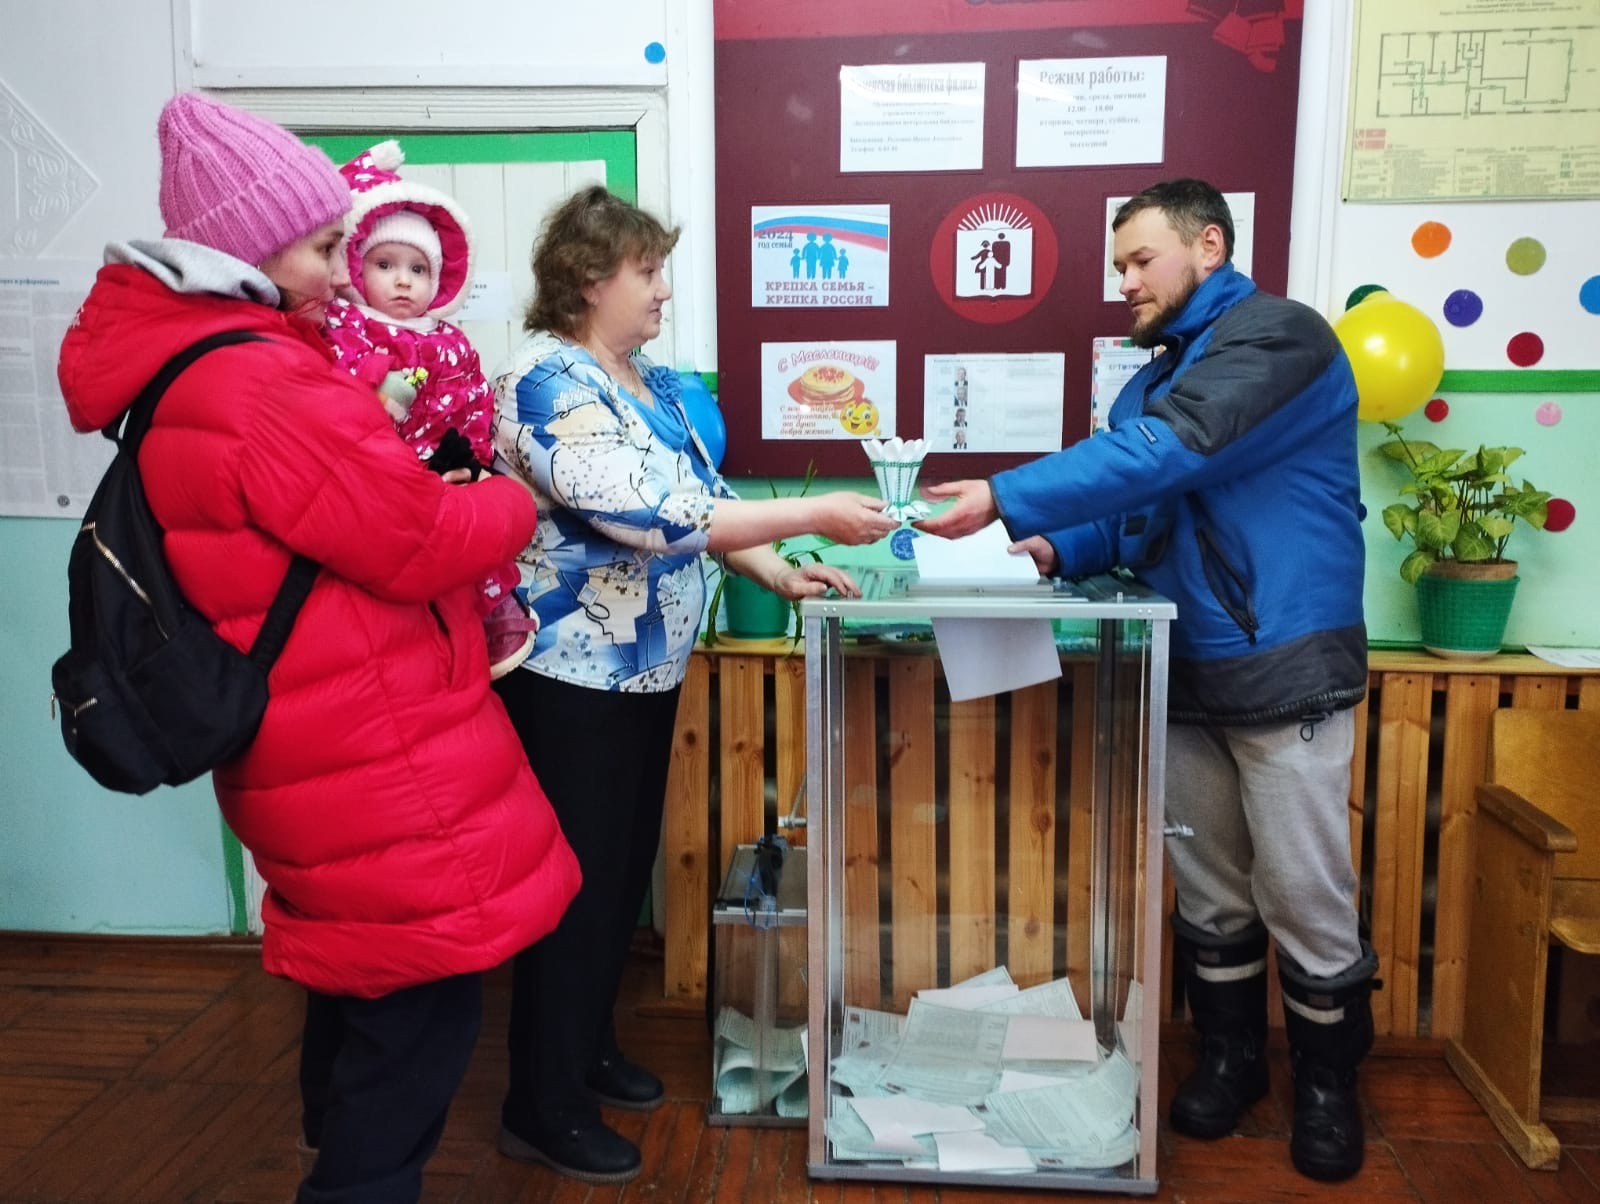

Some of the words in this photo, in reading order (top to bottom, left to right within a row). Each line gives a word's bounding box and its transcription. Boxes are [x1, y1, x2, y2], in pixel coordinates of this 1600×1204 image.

[1040, 70, 1085, 85] Режим
[1089, 66, 1145, 89] работы:
[757, 229, 794, 242] 2024
[758, 241, 770, 249] год
[771, 241, 793, 249] семьи
[765, 281, 818, 291] КРЕПКА
[821, 281, 865, 291] СЕМЬЯ
[766, 294, 819, 305] КРЕПКА
[822, 294, 873, 305] РОССИЯ
[777, 357, 789, 373] С
